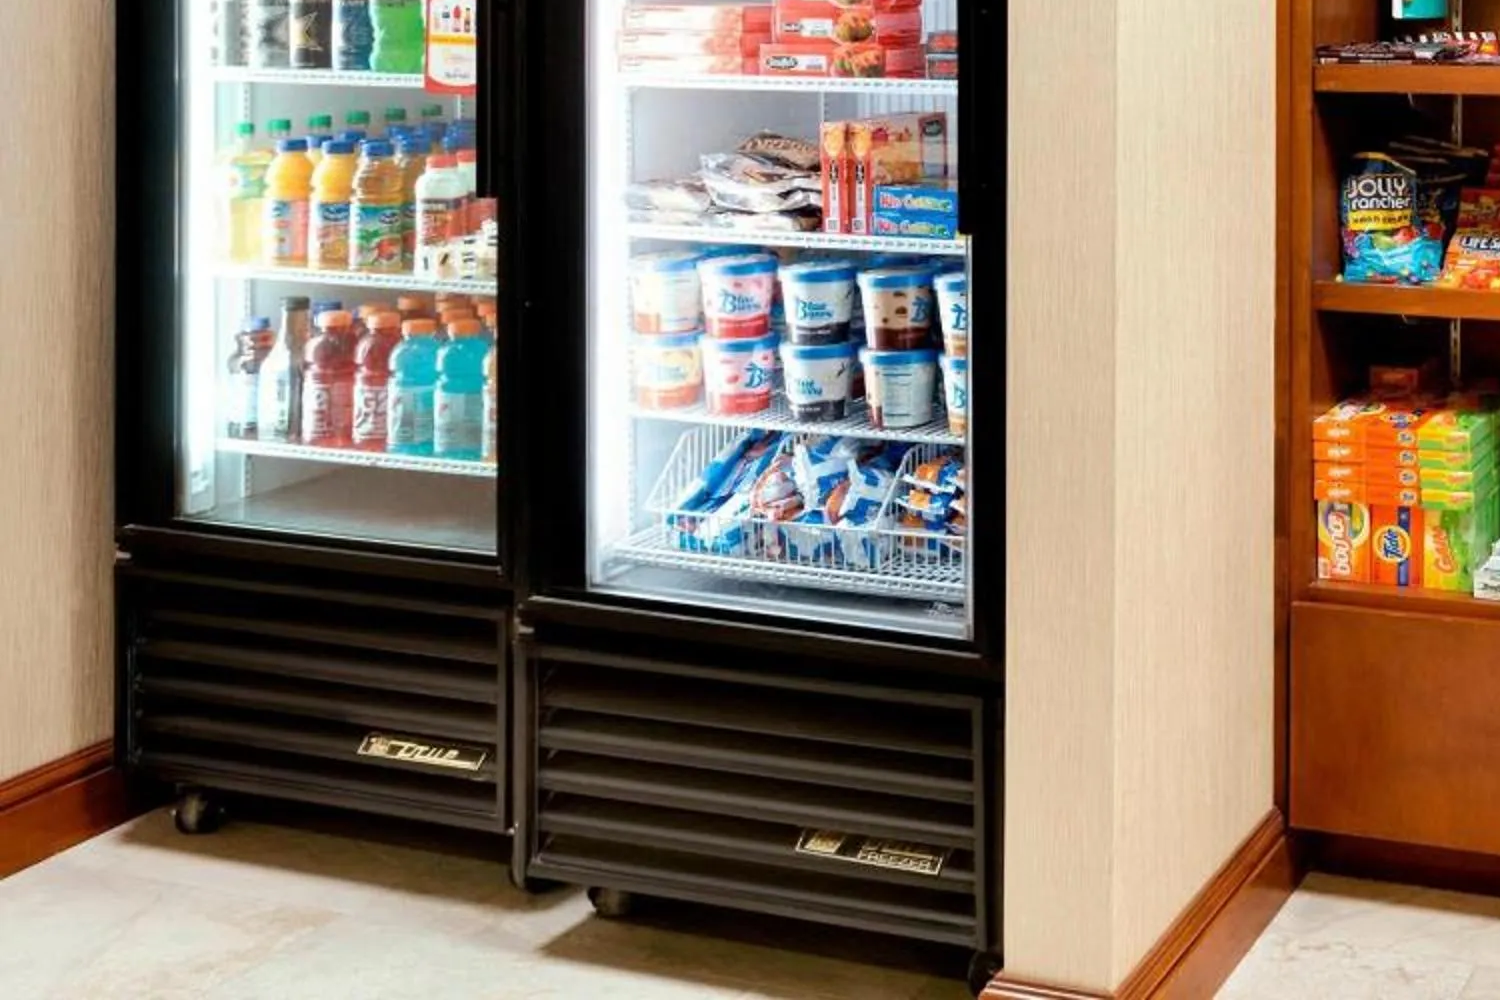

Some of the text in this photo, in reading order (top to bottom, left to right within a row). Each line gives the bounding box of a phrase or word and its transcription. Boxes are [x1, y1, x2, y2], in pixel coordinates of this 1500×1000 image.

[1349, 177, 1408, 198] JOLLY
[1352, 196, 1411, 209] rancher
[1383, 528, 1402, 558] Tide
